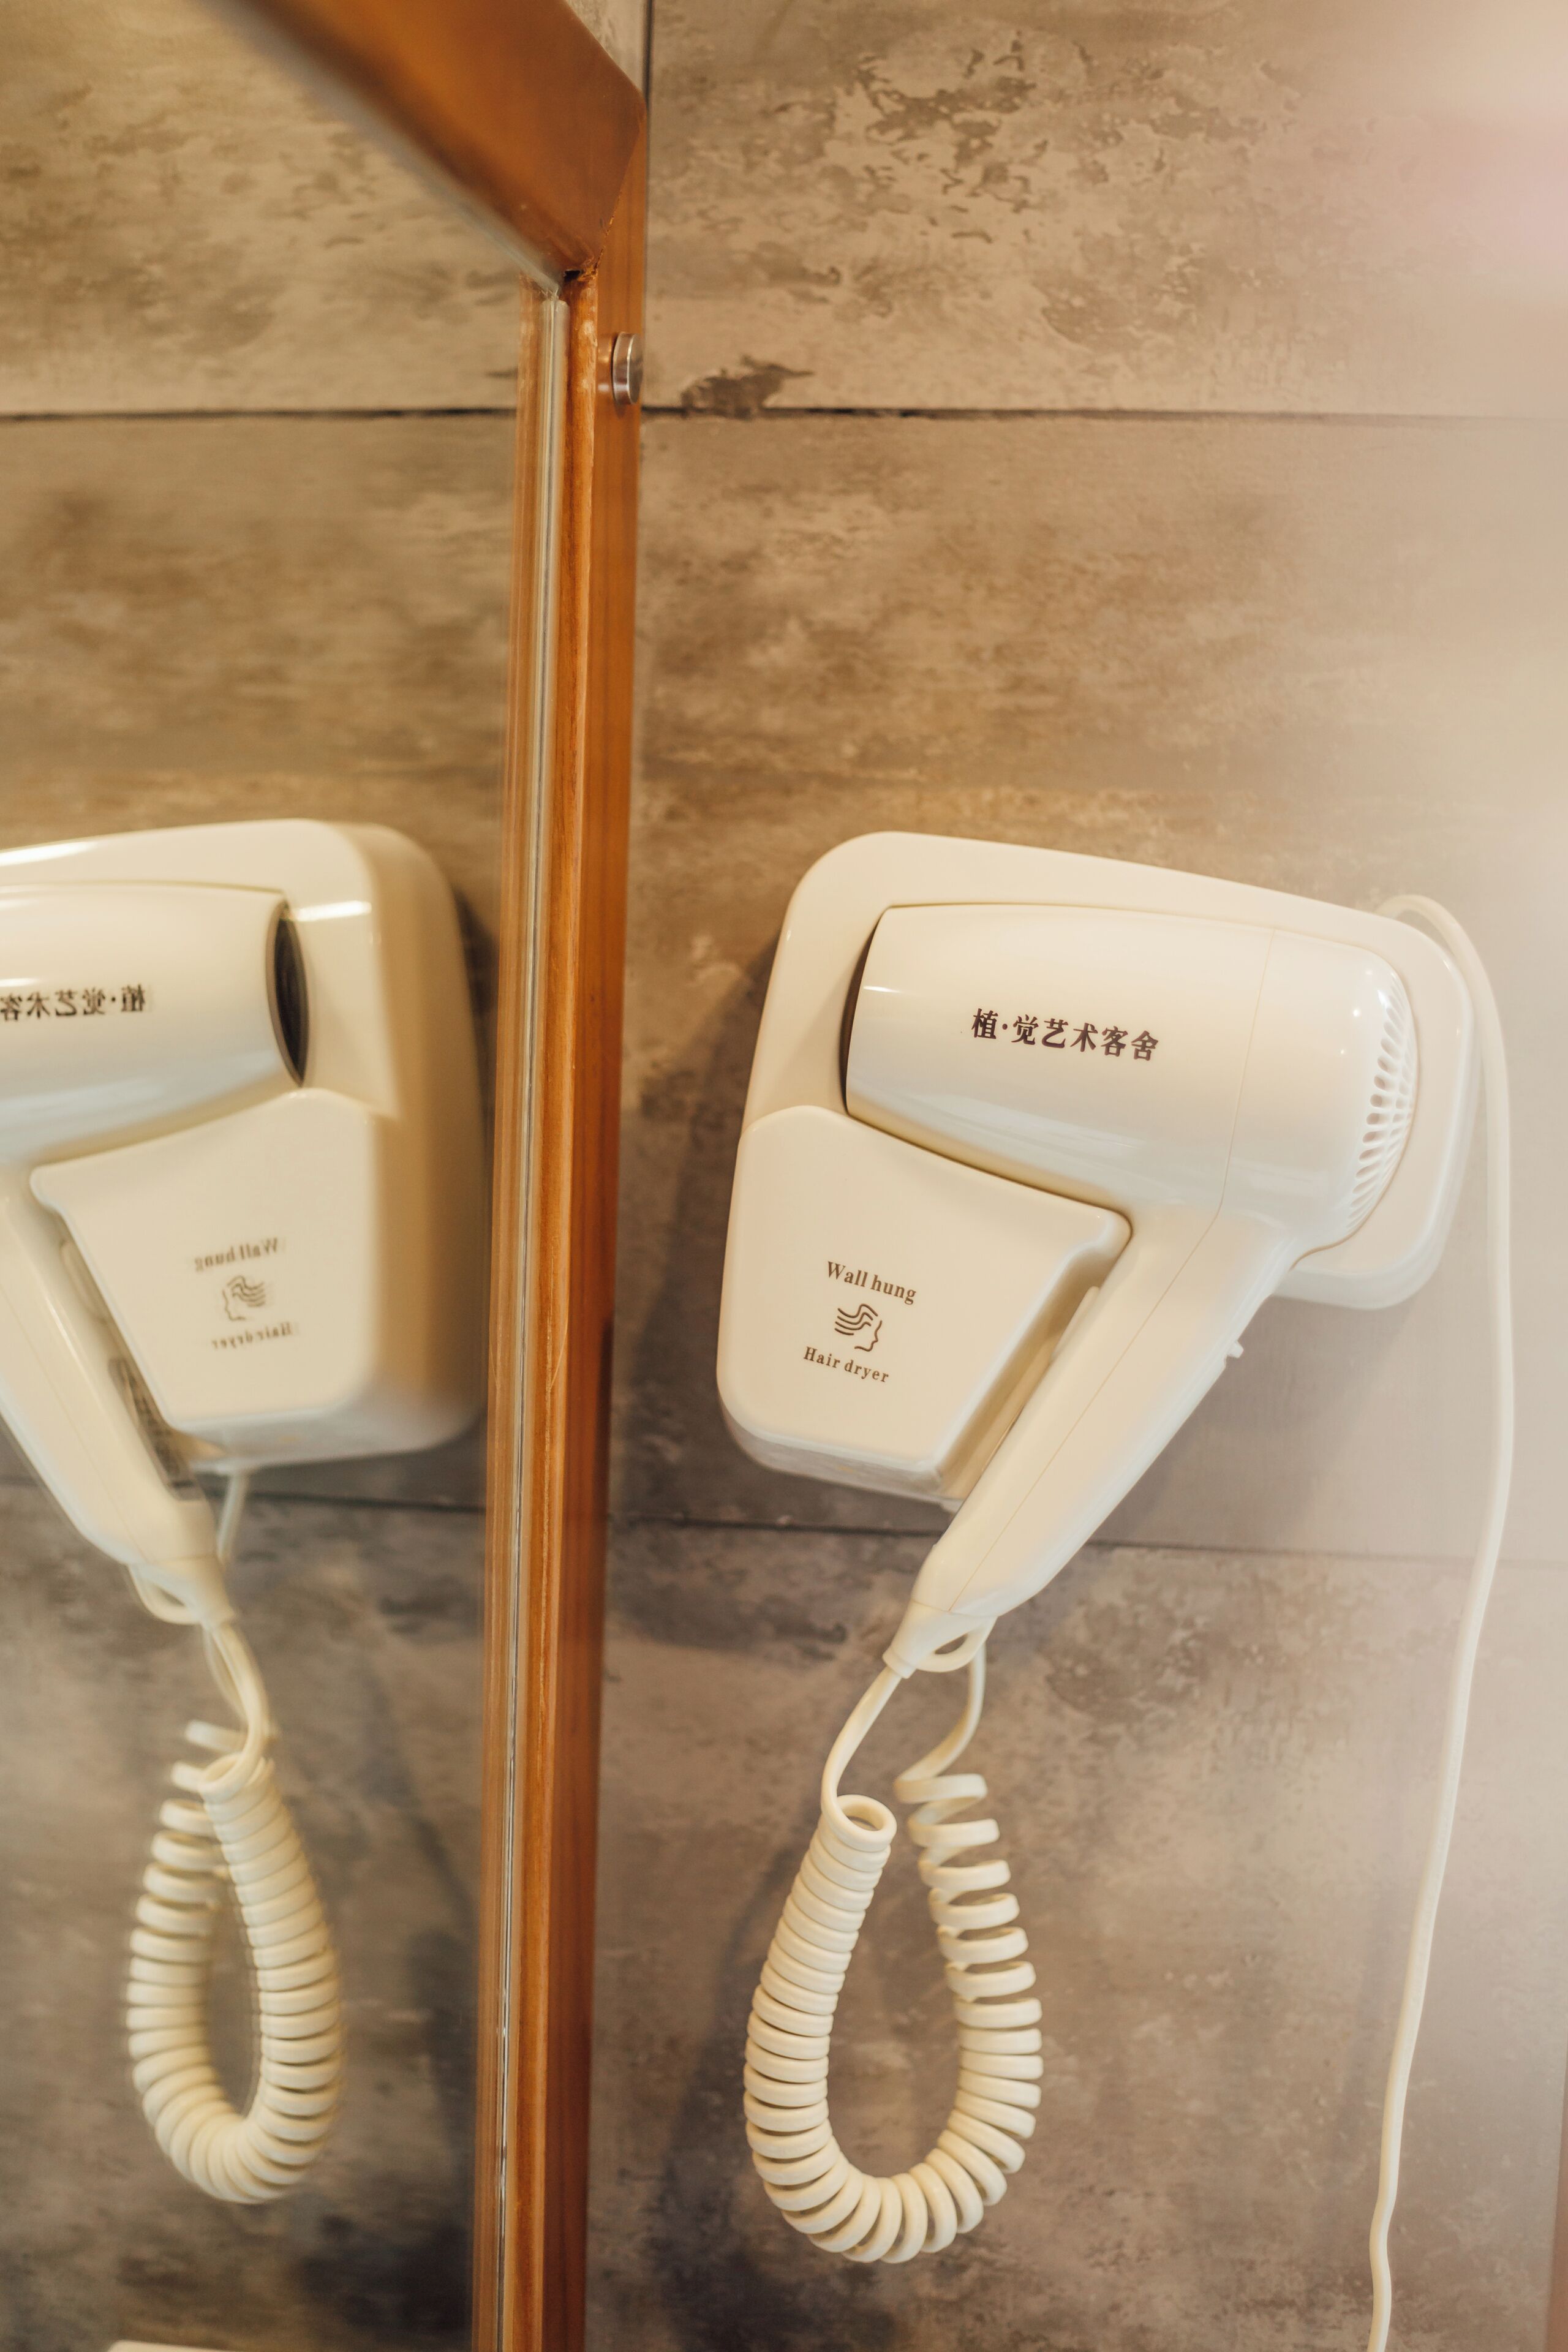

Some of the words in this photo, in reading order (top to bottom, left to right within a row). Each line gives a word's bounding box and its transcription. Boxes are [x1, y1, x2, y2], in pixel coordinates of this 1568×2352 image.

[971, 1008, 1159, 1061] 植·觉艺术客舍
[828, 1261, 868, 1287] Wall
[870, 1275, 917, 1305] hung
[804, 1346, 841, 1368] Hair
[844, 1359, 889, 1382] dryer
